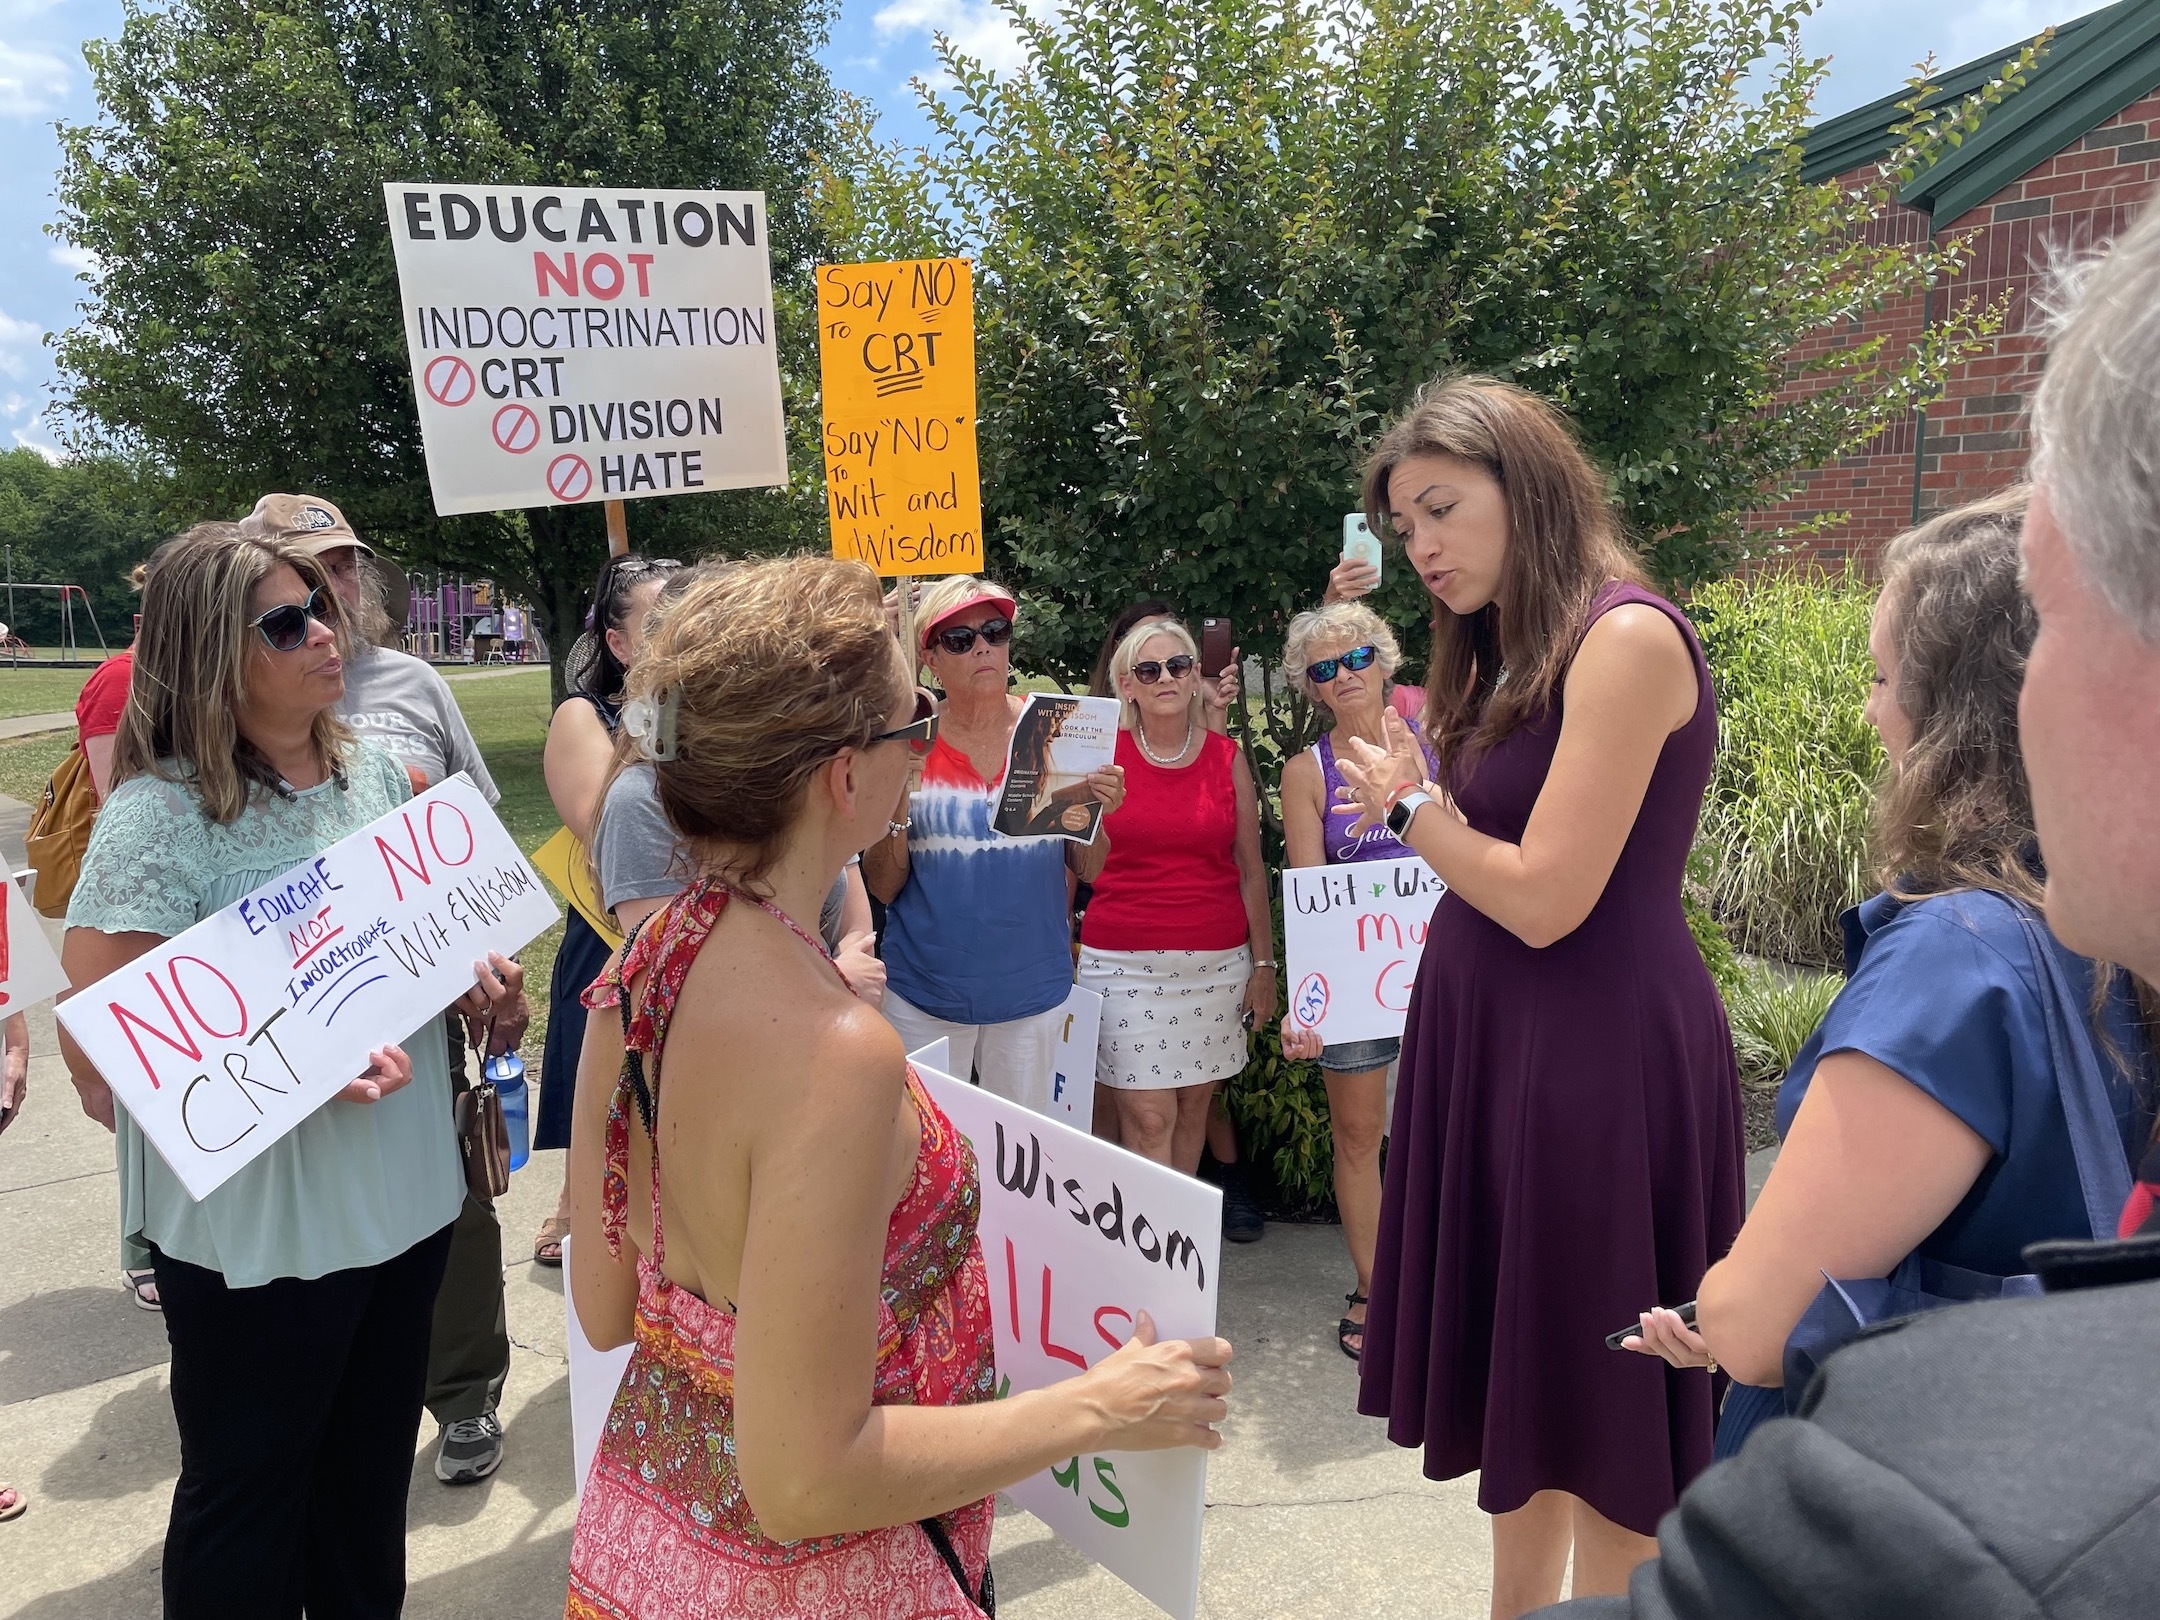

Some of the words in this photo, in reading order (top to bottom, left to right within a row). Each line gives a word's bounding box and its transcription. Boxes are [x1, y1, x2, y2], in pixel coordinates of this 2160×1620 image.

[403, 192, 756, 247] EDUCATION
[533, 251, 655, 301] NOT
[826, 268, 893, 323] Say
[418, 306, 766, 349] INDOCTRINATION
[863, 332, 942, 374] CRT
[481, 356, 565, 400] CRT
[549, 397, 723, 445] DIVISION
[826, 422, 879, 467] Say
[600, 450, 705, 493] HATE
[908, 471, 957, 512] and
[291, 510, 333, 528] NRA
[1037, 709, 1053, 718] WIT
[1054, 709, 1060, 718] &
[1062, 711, 1097, 721] WISDOM
[1059, 733, 1097, 741] URRICULUM
[374, 800, 474, 902] NO
[1293, 873, 1357, 914] Wit
[1393, 867, 1447, 898] Wis
[289, 904, 332, 958] NOT
[382, 912, 451, 978] Wit
[1356, 913, 1428, 952] Mu
[108, 955, 249, 1090] NO
[1299, 980, 1325, 1023] CRT
[181, 1007, 301, 1152] CRT
[994, 1121, 1205, 1292] Wisdom
